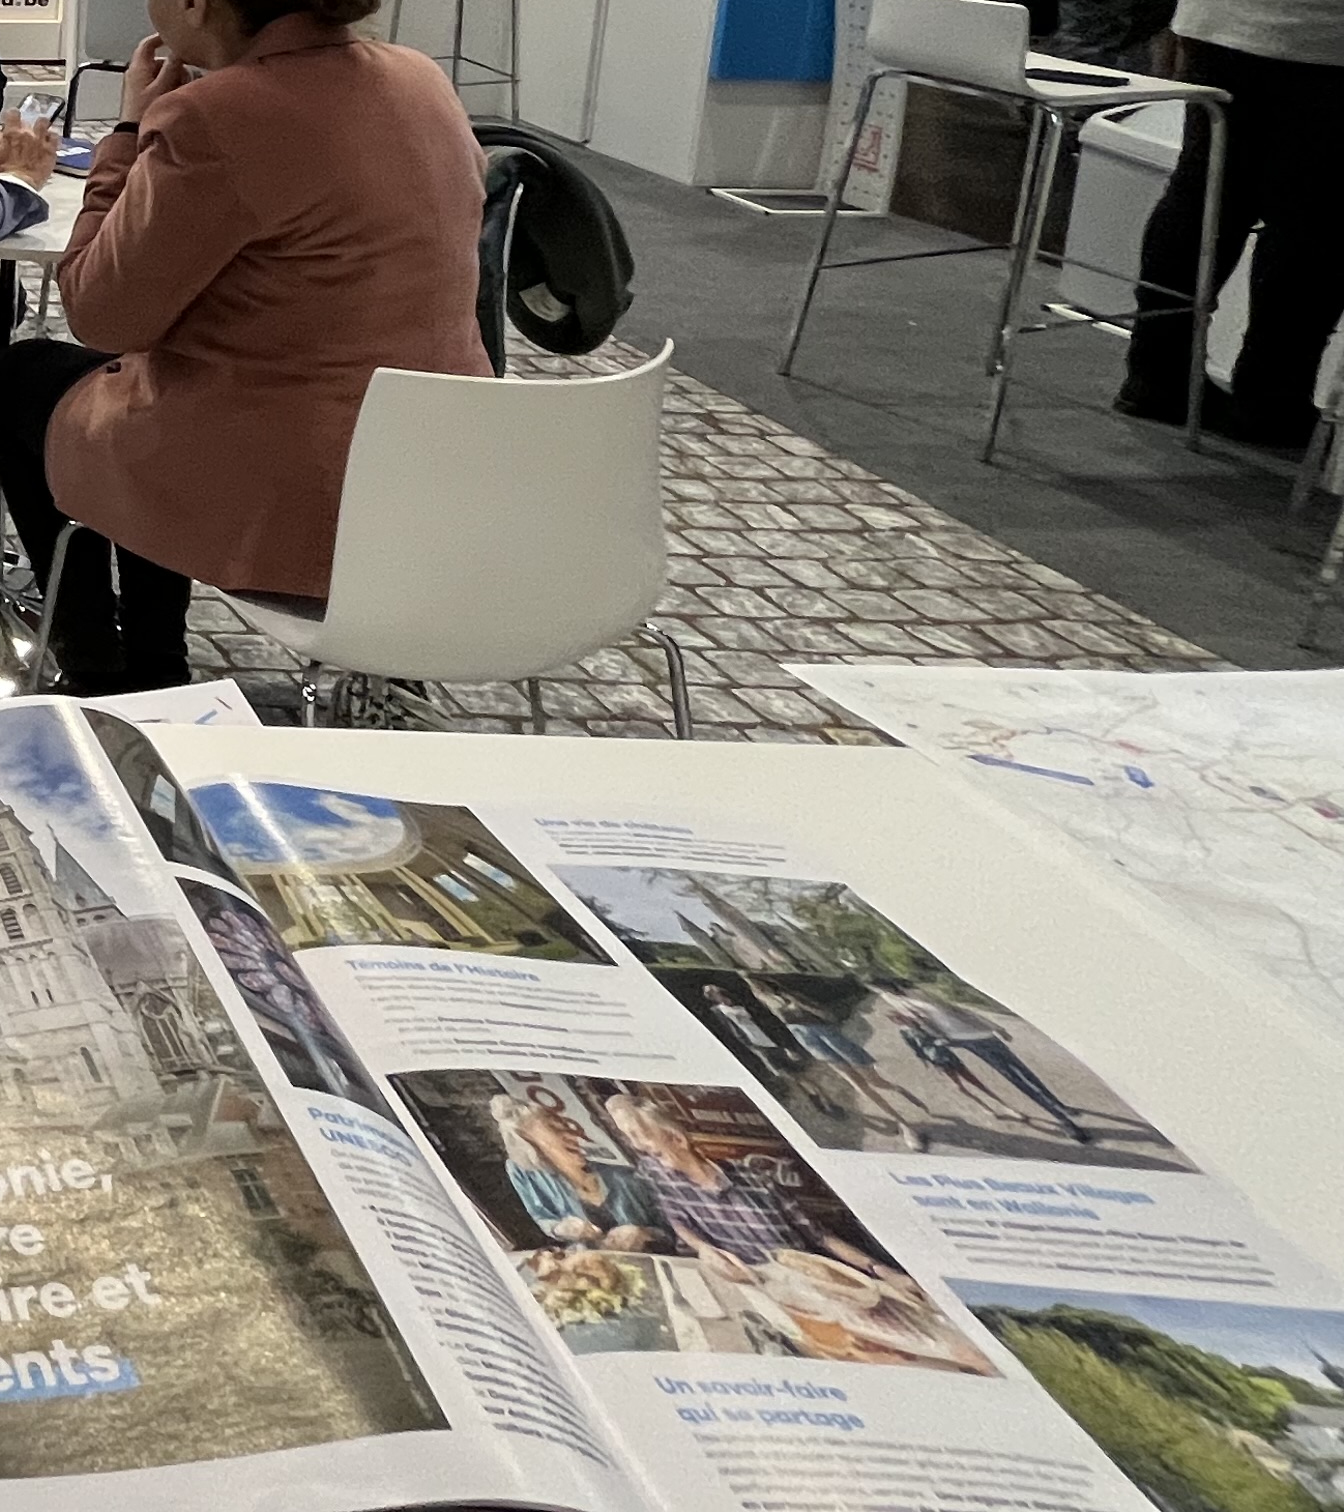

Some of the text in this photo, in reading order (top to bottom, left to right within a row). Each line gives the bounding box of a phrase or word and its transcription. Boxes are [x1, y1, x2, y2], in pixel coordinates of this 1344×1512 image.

[429, 961, 454, 972] de
[92, 1262, 161, 1312] et
[654, 1376, 848, 1402] Un savoir-faire
[677, 1403, 720, 1425] qui
[758, 1409, 866, 1431] partage
